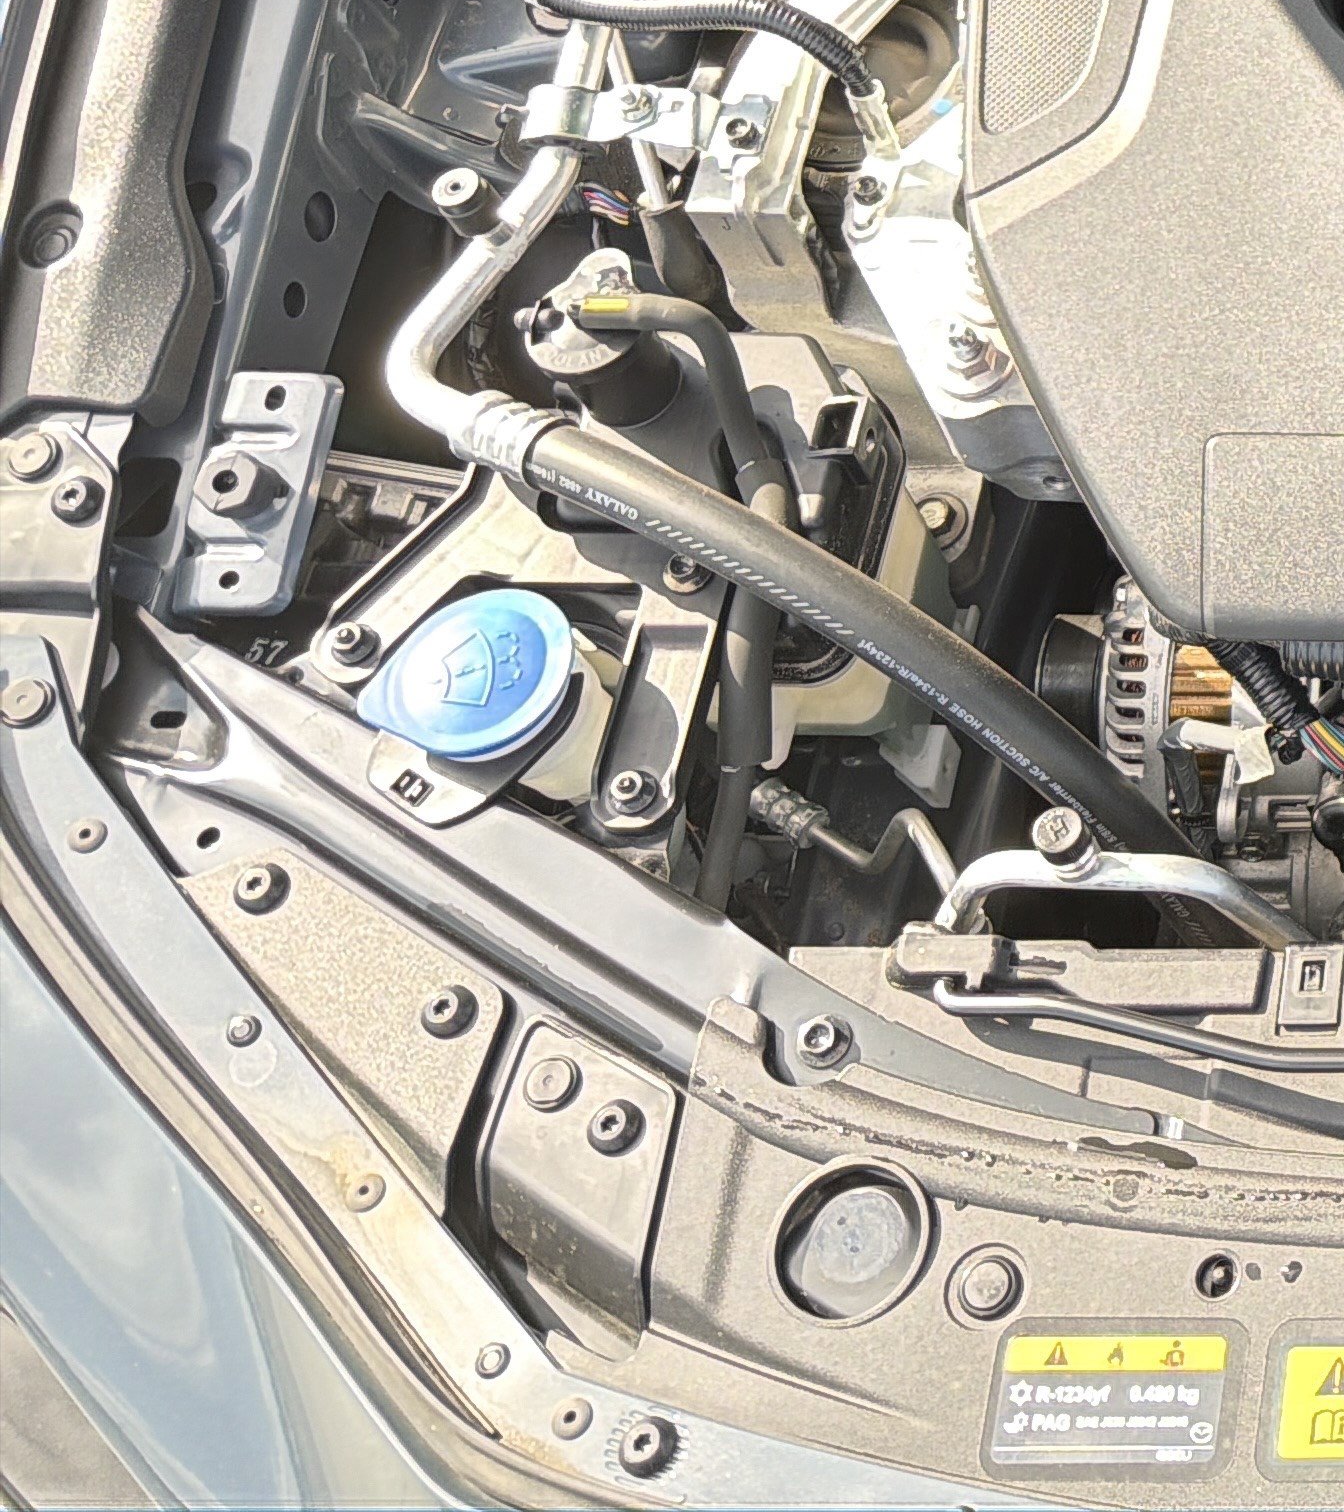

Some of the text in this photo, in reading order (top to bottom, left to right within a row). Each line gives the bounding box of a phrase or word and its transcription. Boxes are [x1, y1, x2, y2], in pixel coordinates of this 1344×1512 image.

[584, 488, 639, 521] GALAXY
[948, 702, 984, 730] HOSE
[981, 727, 1032, 768] SUCTION
[1028, 764, 1050, 783] A/C
[1031, 1413, 1071, 1432] PAG
